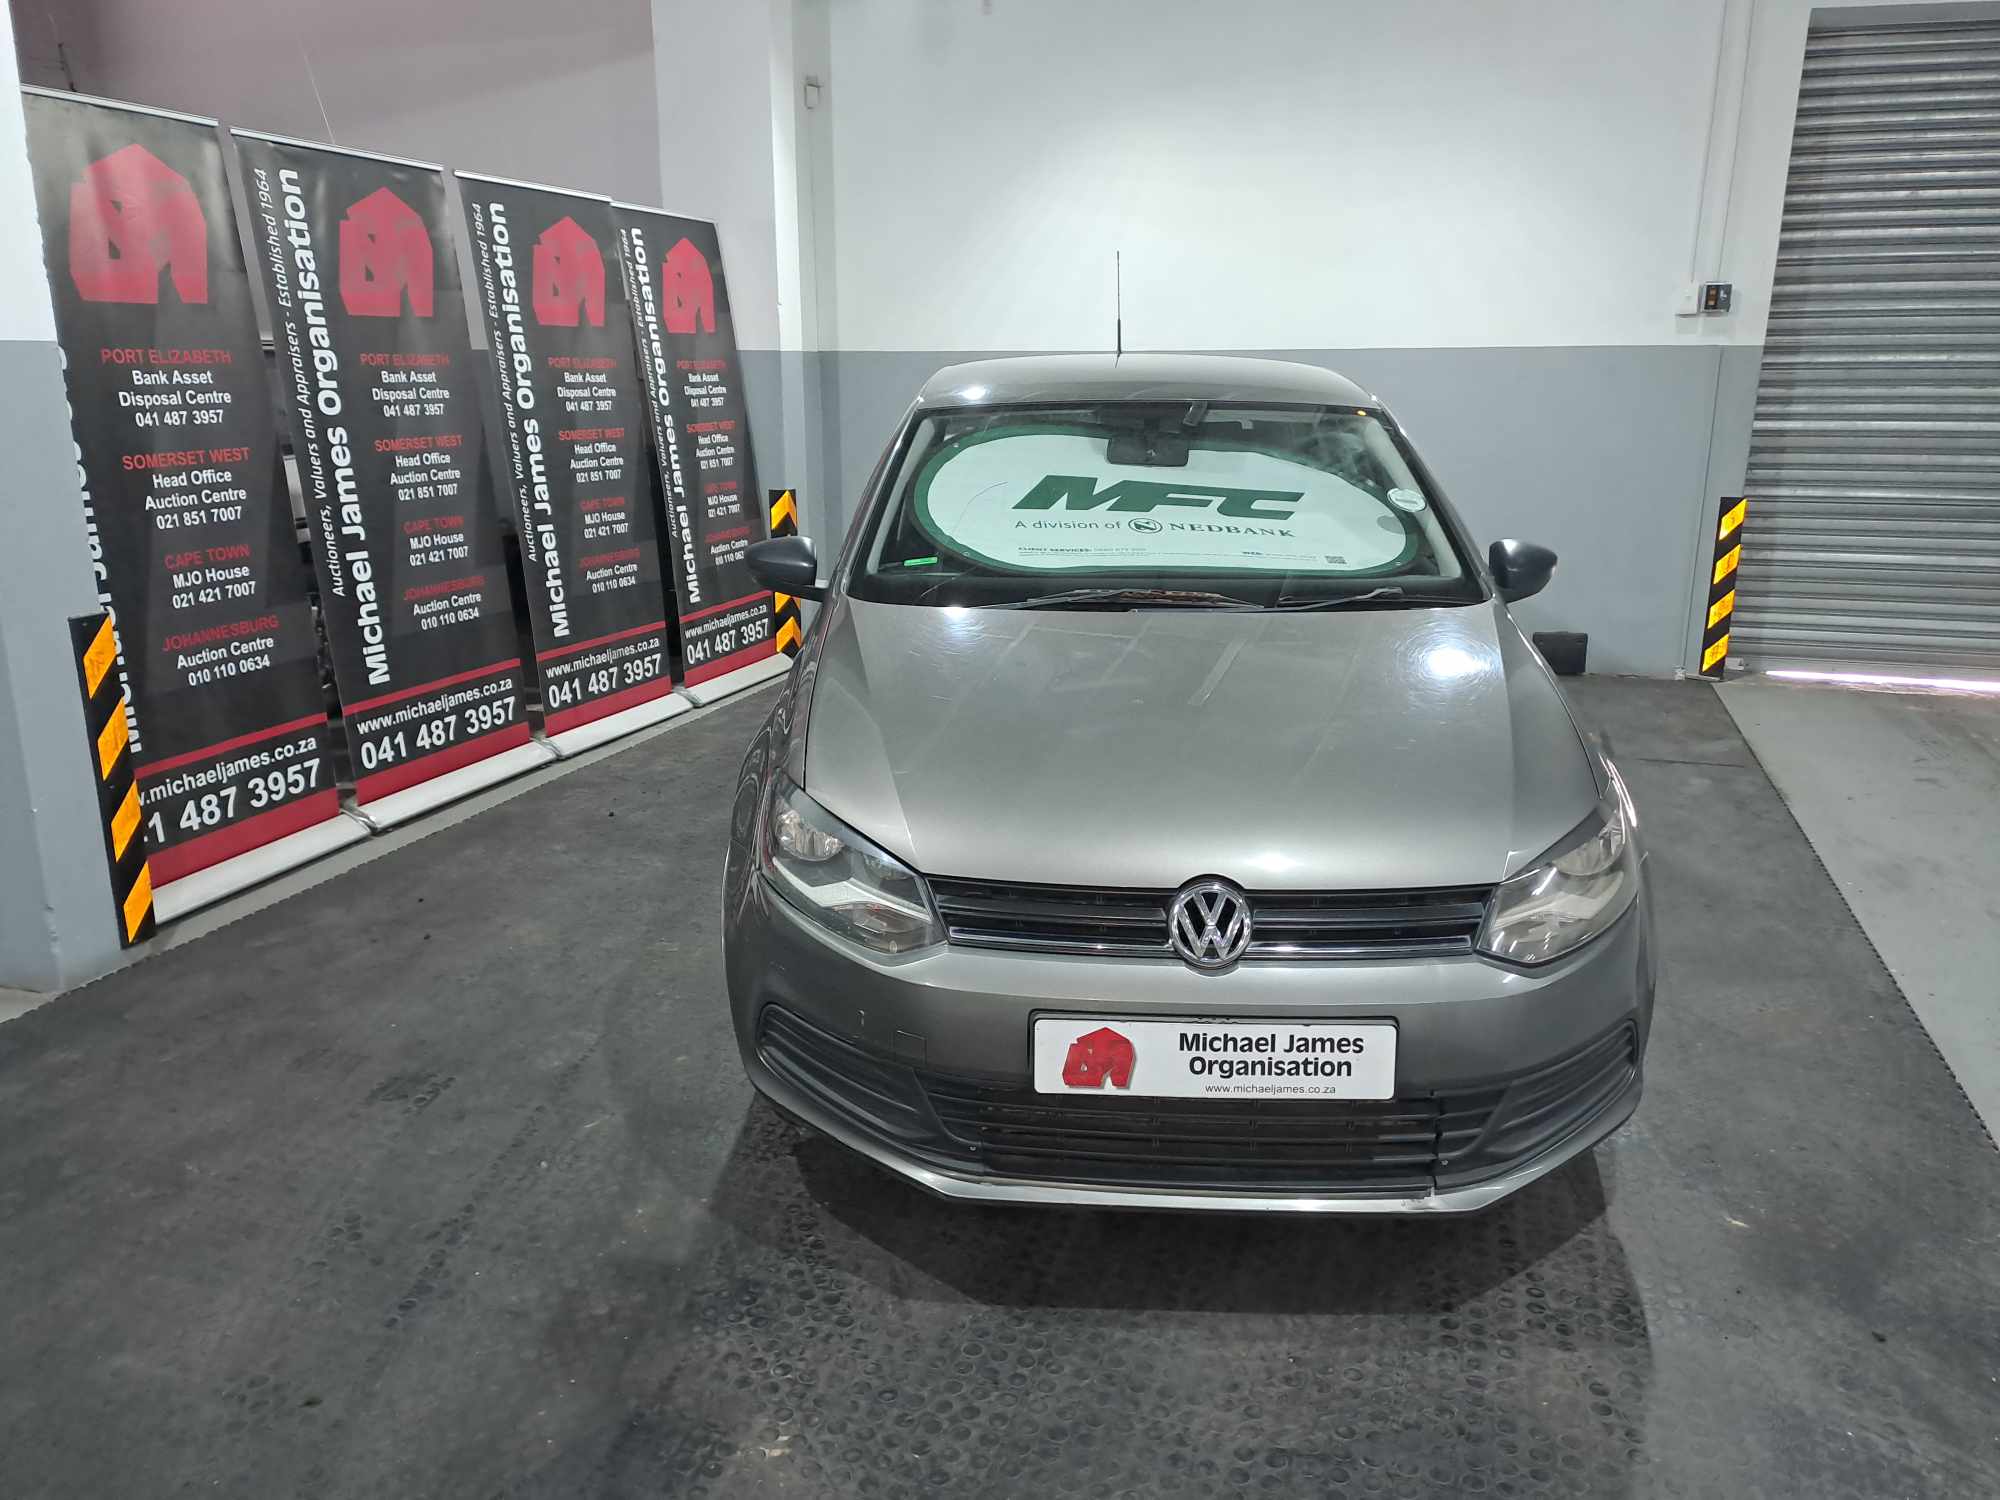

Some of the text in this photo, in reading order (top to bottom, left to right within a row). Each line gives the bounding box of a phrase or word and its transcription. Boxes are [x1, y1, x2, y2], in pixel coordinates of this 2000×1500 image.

[101, 349, 232, 365] PORT ELIZABETH
[360, 354, 390, 366] PORT
[132, 370, 213, 385] Bank Asset
[254, 168, 346, 597] Auctioneers, Valuers and Appraisers Established 1964
[381, 371, 436, 383] Bank Asset
[471, 202, 537, 562] Auctioneers, Valuers and Appraisers Established 1964
[564, 372, 607, 383] Bank Asset
[118, 390, 232, 409] Disposal Centre
[372, 387, 449, 402] Disposal Centre
[557, 386, 616, 399] Disposal Centre
[384, 404, 444, 417] 041 487 3957
[566, 401, 612, 412] 041 487 3957
[631, 228, 700, 603] Michael James Organisation
[135, 409, 224, 427] 041 487 3957
[279, 169, 390, 685] Michael James Organisation
[489, 202, 570, 638] Michael James Organisation
[574, 442, 617, 454] Head Office
[122, 448, 250, 471] SOMERSET WEST
[395, 452, 450, 467] Head Office
[570, 456, 624, 469] Auction Centre
[152, 469, 232, 489] Head Office
[390, 468, 461, 485] Auction Centre
[576, 473, 589, 483] 021
[605, 469, 622, 479] 7007
[145, 488, 247, 511] Auction Centre
[398, 484, 458, 501] 021 851 7007
[1011, 474, 1304, 520] MFC
[156, 506, 243, 530] 021 851 7007
[601, 512, 625, 522] House
[1014, 518, 1296, 538] A division of NEDBANK
[410, 532, 464, 549] MJO House
[584, 523, 629, 539] 021 421 7007
[164, 545, 250, 571] CAPE TOWN
[410, 546, 469, 567] 021 421 7007
[172, 565, 250, 589] MJO House
[586, 564, 638, 581] Auction Centre
[172, 581, 257, 610] 021 421 7007
[592, 582, 605, 593] 010
[413, 592, 482, 616] Auction Centre
[421, 607, 480, 630] 010 110 0634
[685, 604, 766, 639] www.michaeljames.co.za
[162, 616, 279, 652] JOHANNESBURG
[687, 618, 768, 664] 041 487 3957
[177, 636, 275, 670] Auction Centre
[545, 637, 660, 679] www.michaeljames.co.za
[188, 654, 271, 687] 010 110 0634
[548, 653, 662, 709] 041 487 3957
[356, 677, 513, 735] www.michaeljames.co.za
[360, 696, 517, 770] 041 487 3957
[137, 737, 317, 806] .michaeljames.co.za
[179, 786, 239, 832] 487
[247, 758, 321, 808] 3957
[1179, 1032, 1365, 1054] Michael James
[1188, 1056, 1353, 1079] Organisation
[1204, 1083, 1337, 1096] www.michaeljames.co.za
